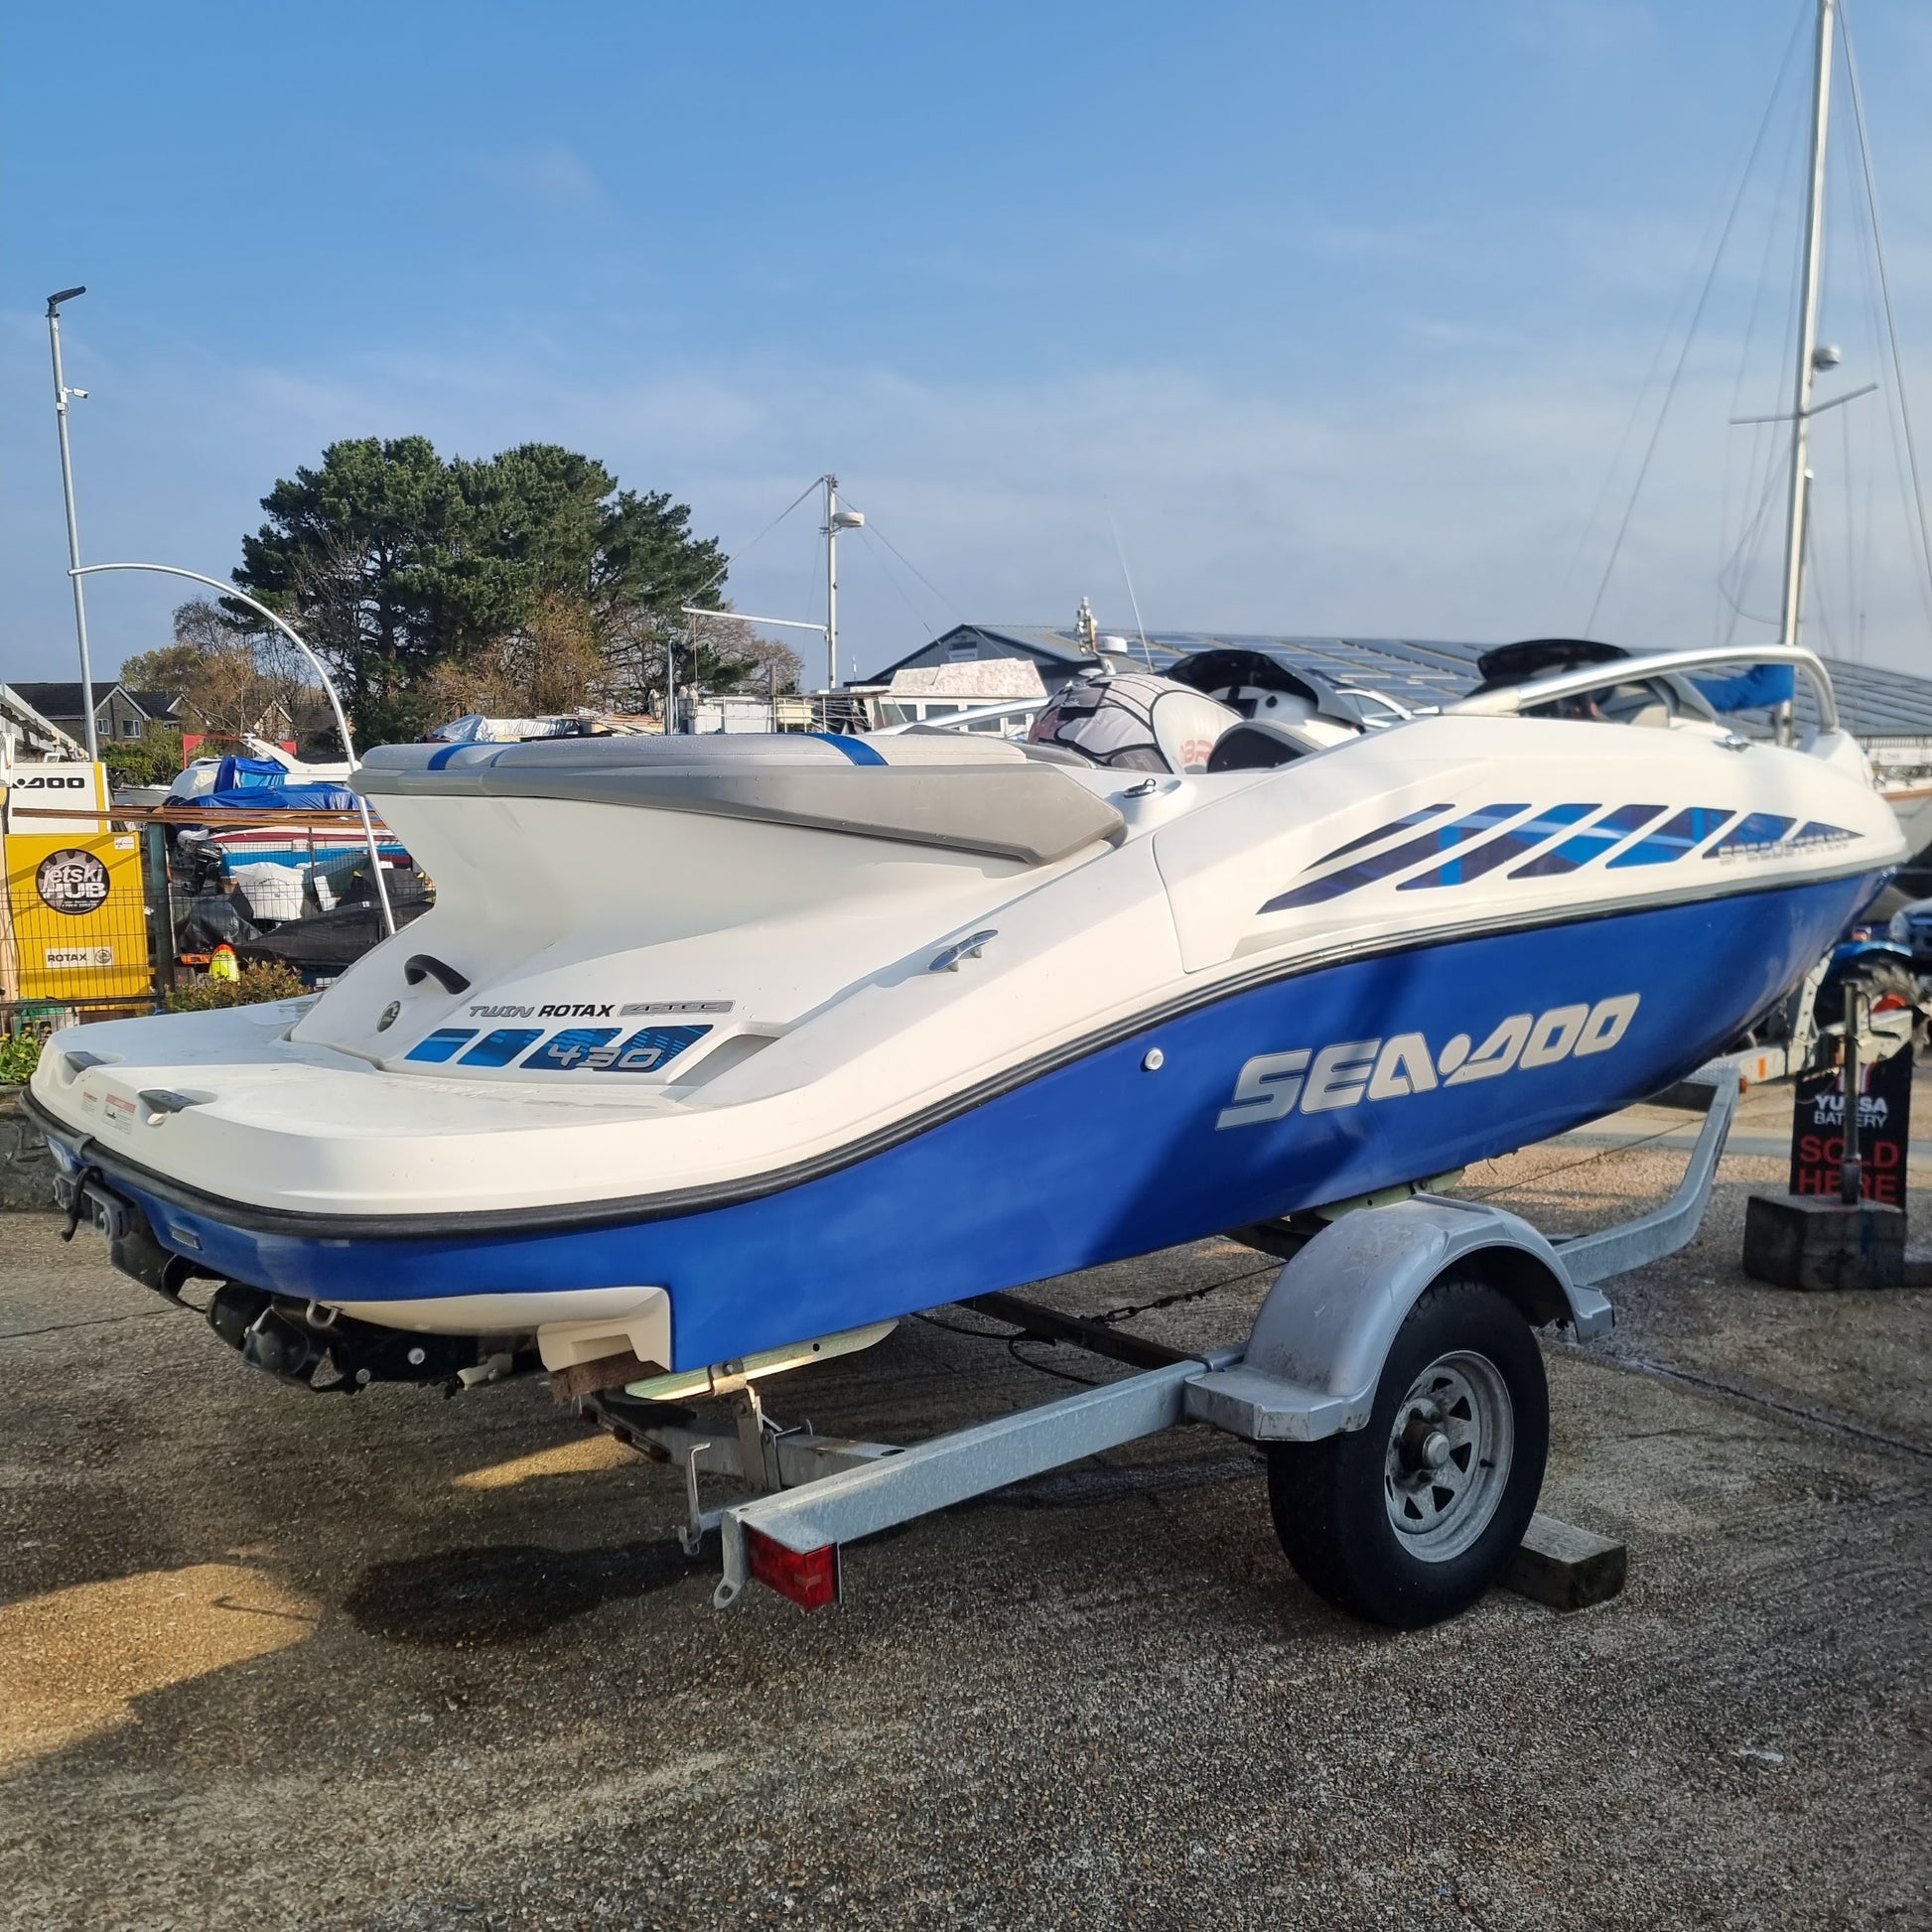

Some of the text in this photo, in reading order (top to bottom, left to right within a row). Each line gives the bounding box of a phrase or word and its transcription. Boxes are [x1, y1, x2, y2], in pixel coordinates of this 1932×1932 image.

[42, 883, 106, 899] HUB
[48, 953, 87, 962] ROTAX
[469, 1005, 535, 1019] TWIN
[537, 1004, 616, 1018] ROTAX
[547, 1042, 662, 1069] 430
[1815, 1094, 1887, 1113] YUSA
[1813, 1110, 1887, 1129] BATERY
